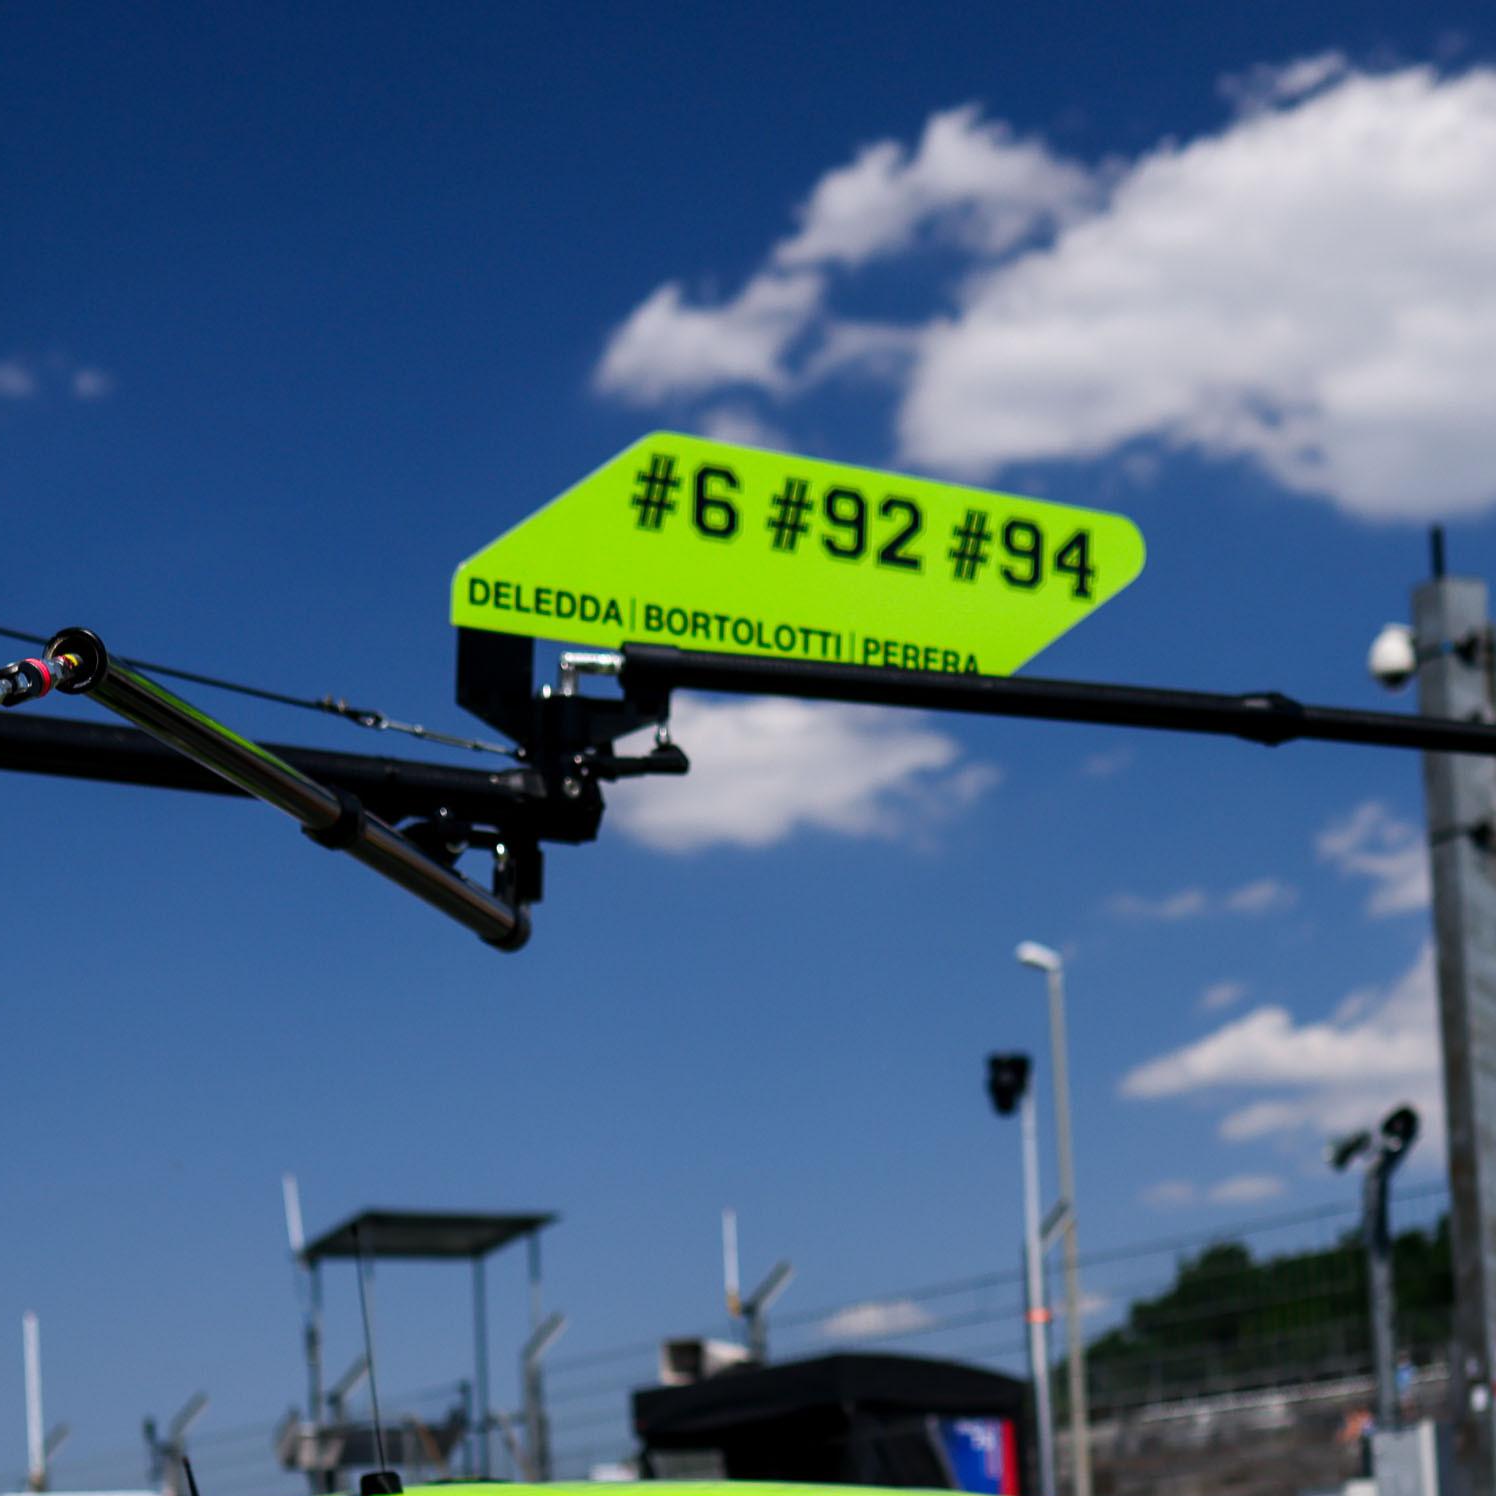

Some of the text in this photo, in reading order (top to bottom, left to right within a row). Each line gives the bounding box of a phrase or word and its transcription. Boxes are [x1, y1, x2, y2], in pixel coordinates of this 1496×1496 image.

[630, 454, 1098, 602] #6 #92 #94
[468, 577, 624, 628] DELEDDA
[644, 606, 842, 661] BORTOLOTTI
